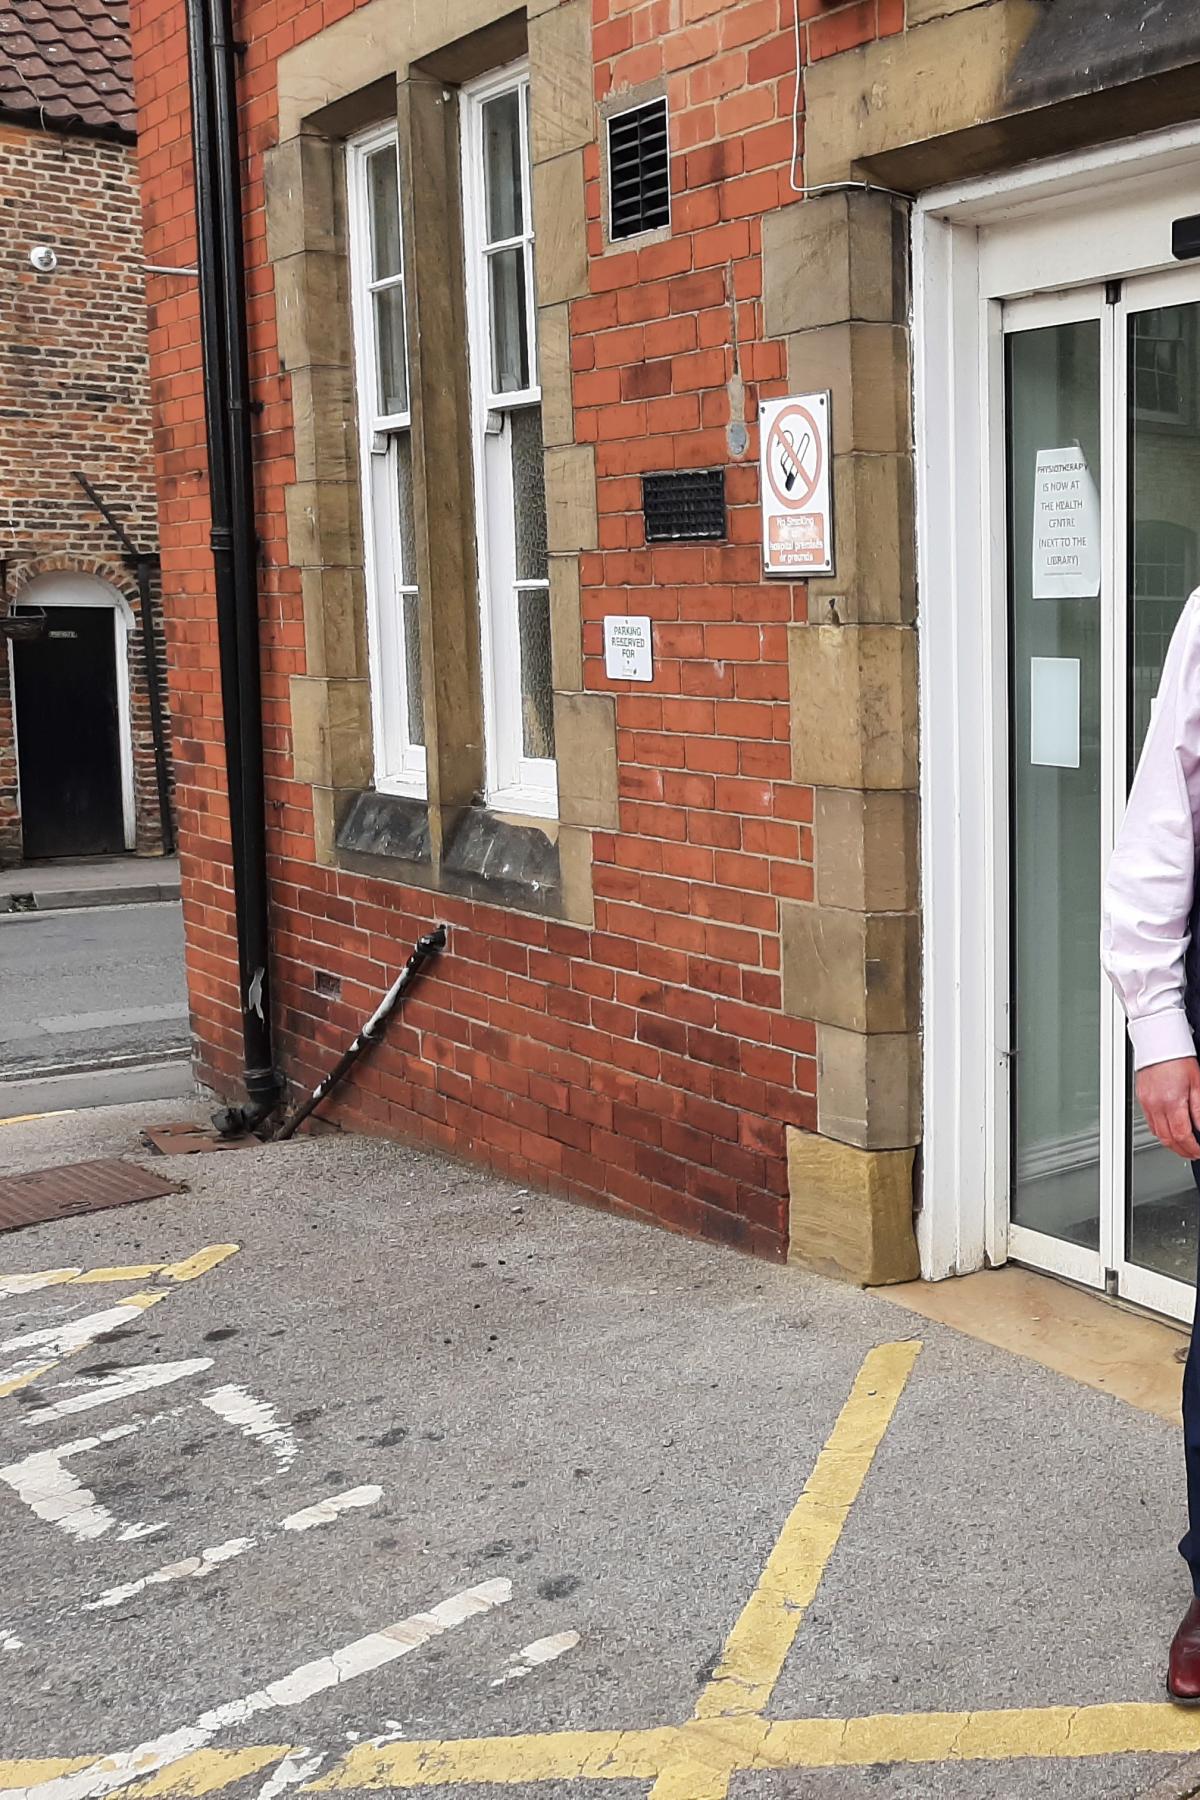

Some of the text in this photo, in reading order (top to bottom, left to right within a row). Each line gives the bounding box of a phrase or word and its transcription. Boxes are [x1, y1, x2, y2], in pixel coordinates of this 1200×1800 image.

[1042, 480, 1081, 492] IS NOW AT
[1040, 500, 1083, 511] THE HEALTH
[1048, 518, 1076, 528] CENTRE
[1060, 537, 1071, 547] TO
[1071, 536, 1087, 547] THE
[613, 625, 642, 637] PARKING
[611, 636, 645, 648] RESERVED
[621, 648, 635, 659] FOR
